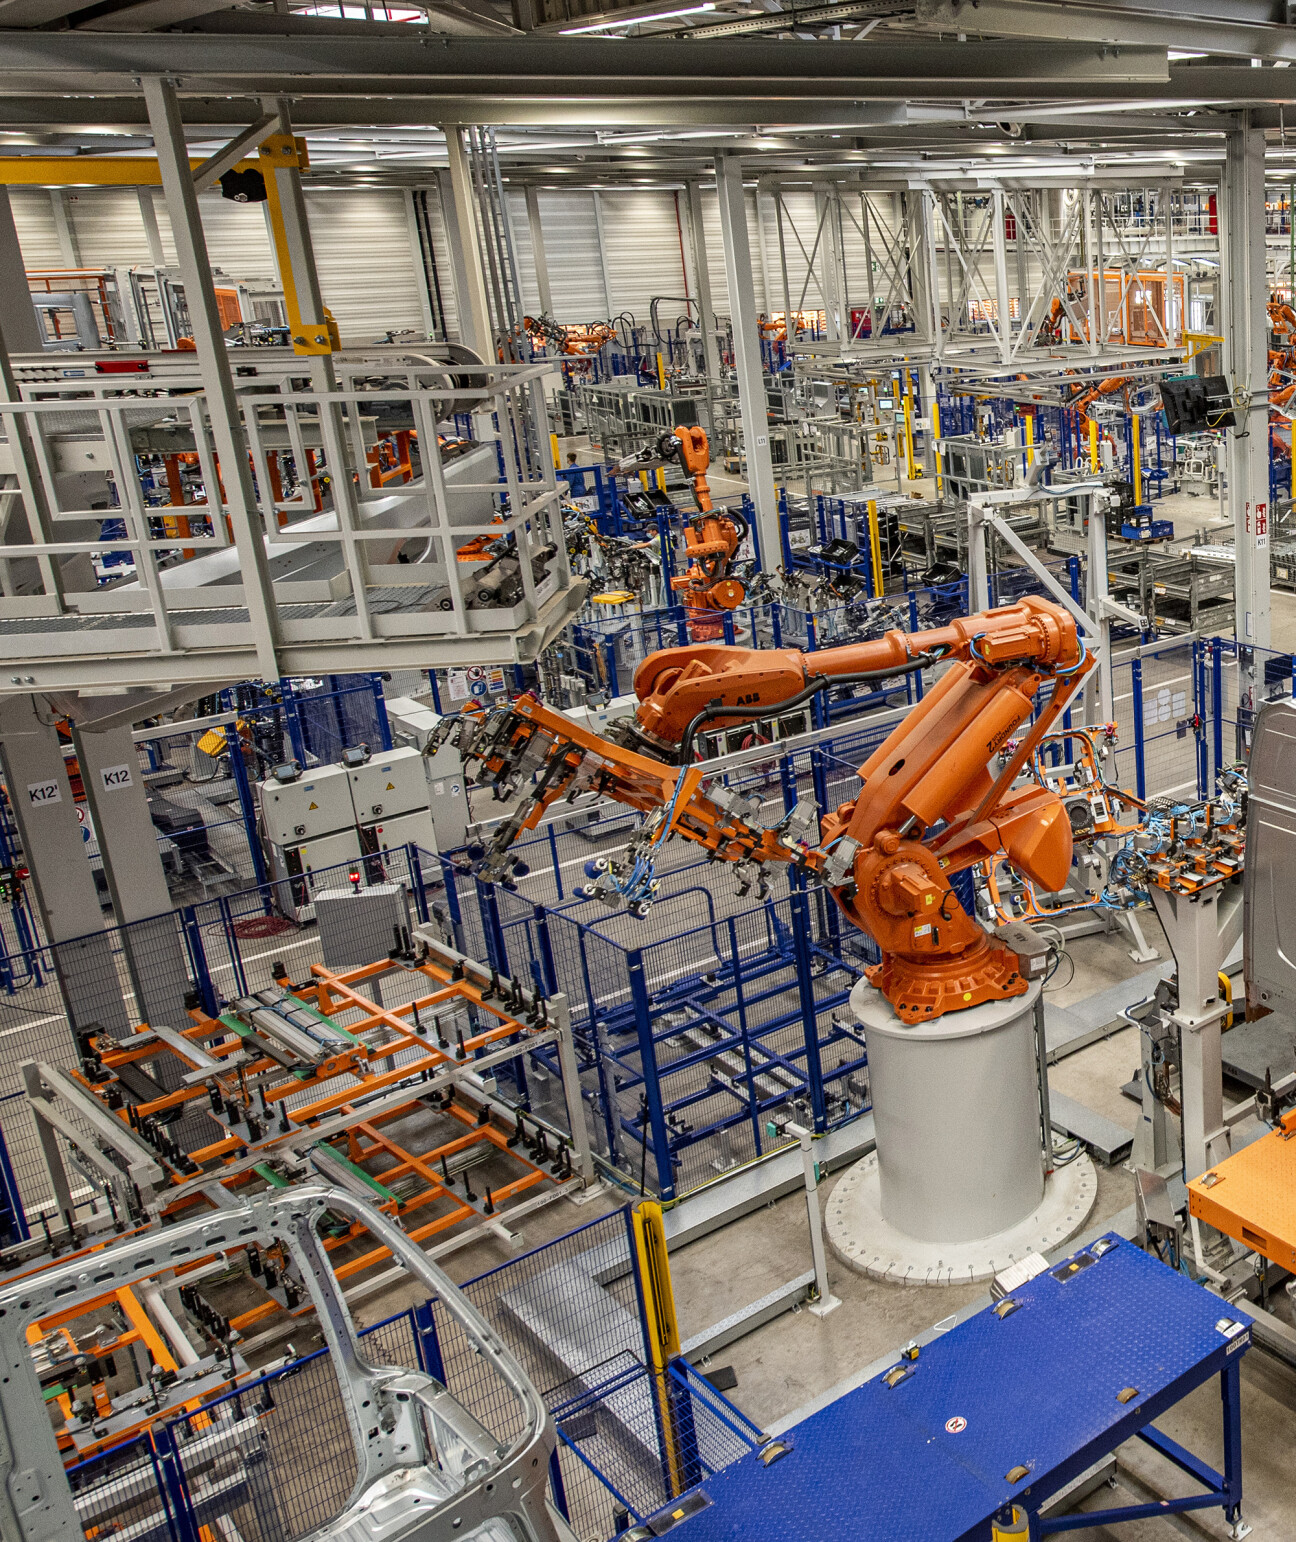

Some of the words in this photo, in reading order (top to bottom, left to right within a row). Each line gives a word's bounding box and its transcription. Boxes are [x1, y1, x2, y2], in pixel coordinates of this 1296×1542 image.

[736, 693, 760, 706] ABB
[104, 770, 130, 785] K12
[29, 785, 58, 801] K12'
